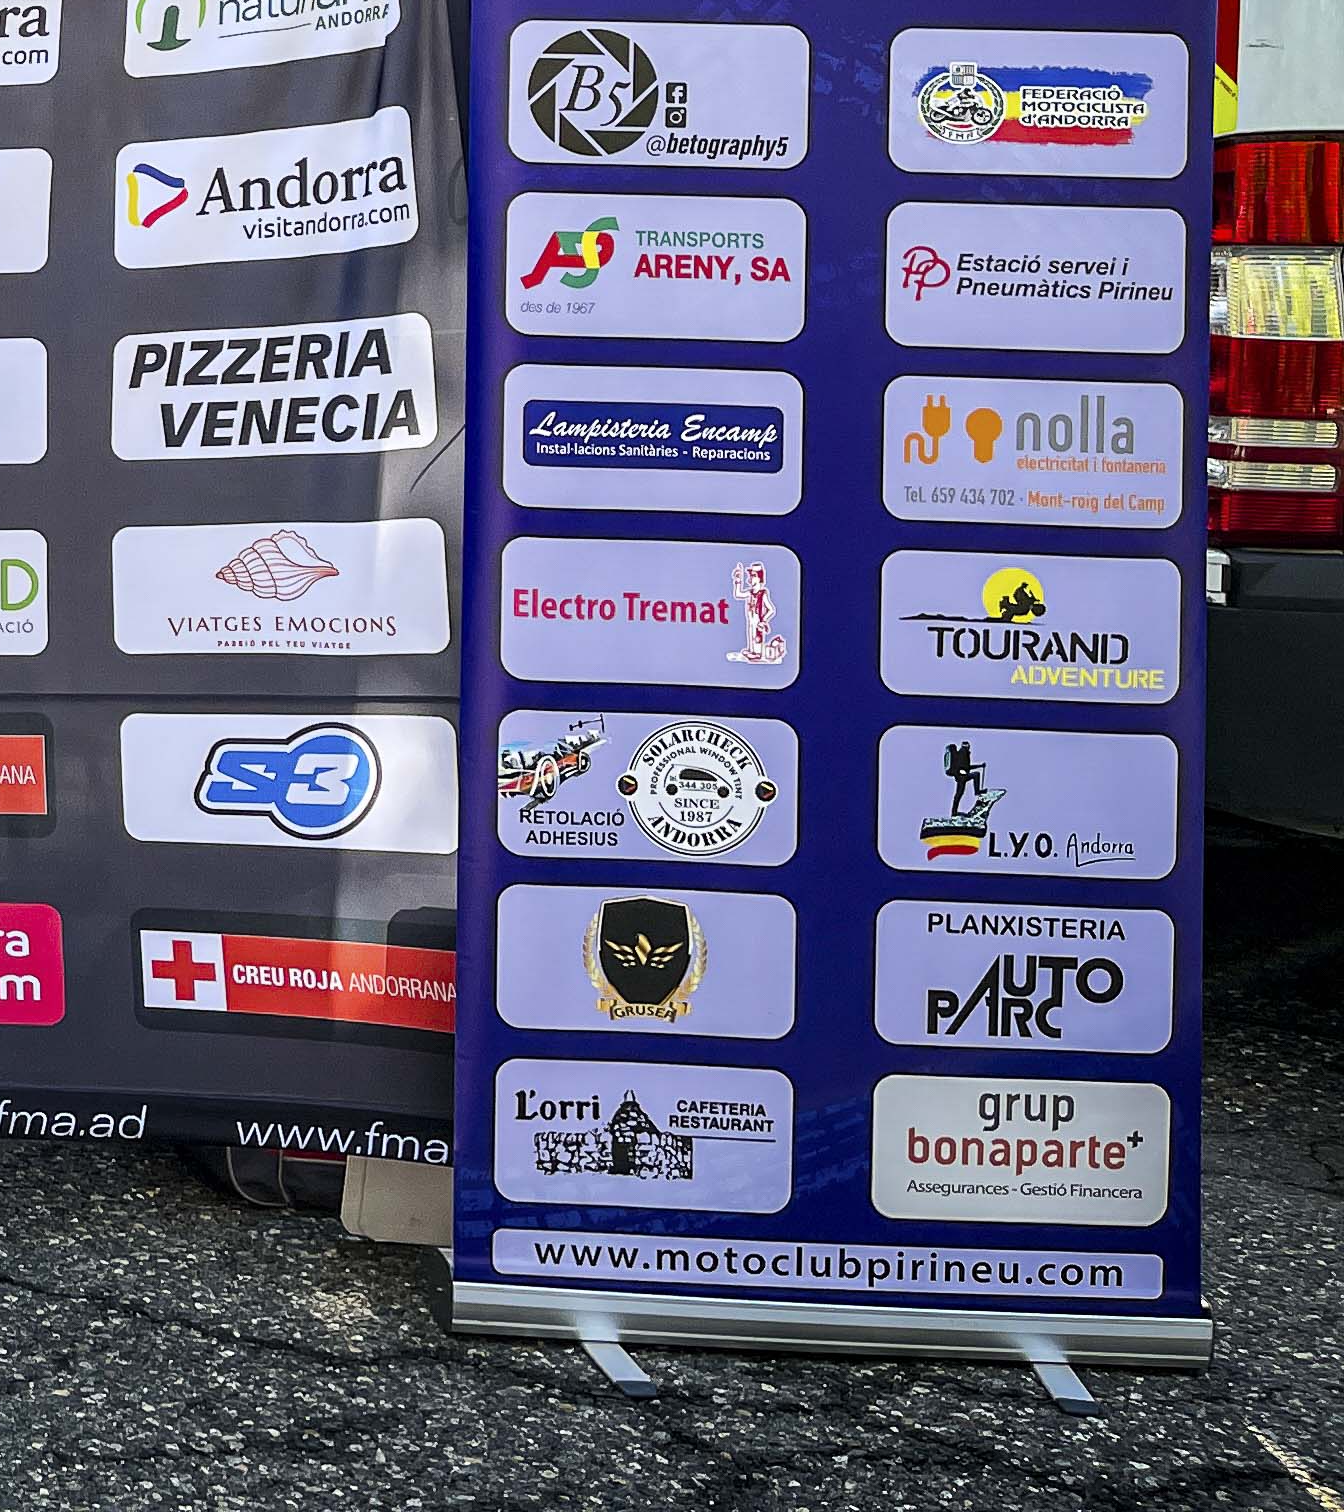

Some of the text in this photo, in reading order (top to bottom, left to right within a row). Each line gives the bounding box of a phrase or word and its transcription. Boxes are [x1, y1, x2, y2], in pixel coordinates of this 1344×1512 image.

[1021, 86, 1121, 100] FEDERACIÓ
[1021, 101, 1144, 115] MOTOCICLISTA
[1021, 114, 1129, 127] d'ANDORRA
[645, 132, 789, 161] @betography5
[196, 154, 408, 217] Andorra
[243, 201, 410, 241] visitandorra.com
[635, 230, 766, 250] TRANSPORTS
[633, 254, 791, 286] ARENY, SA
[956, 252, 1129, 277] Estació servei i
[955, 277, 1174, 302] Pneumàtics Pirineu
[520, 299, 596, 316] des de 1967
[127, 327, 393, 390] PIZZERIA
[159, 389, 422, 449] VENECIA
[527, 408, 779, 447] Lampisteria Encamp
[1017, 393, 1135, 455] nolla
[619, 443, 679, 460] Sanitàries
[692, 445, 771, 464] Reparacions
[1016, 454, 1091, 474] electricitat
[1101, 456, 1167, 476] fontaneria
[931, 486, 957, 506] 659
[960, 487, 986, 507] 434
[989, 488, 1015, 507] 702
[1026, 490, 1100, 514] Mont-roig
[1103, 492, 1125, 512] del
[1128, 493, 1166, 515] Camp
[513, 588, 730, 626] Electro Tremat
[167, 614, 398, 637] VIATGES EMOCIONS
[261, 640, 280, 649] PEL
[287, 640, 305, 649] TEU
[311, 640, 351, 649] VIATGE
[927, 627, 1130, 666] TOURAND
[1010, 665, 1165, 690] ADVENTURE
[642, 729, 753, 771] SOLARCHECK
[650, 746, 743, 800] PROFESSIONAL WINDOW TINT
[674, 797, 720, 809] SINCE
[519, 809, 626, 827] RETOLACIÓ
[679, 810, 713, 823] 1987
[525, 830, 618, 847] ADHESIUS
[647, 815, 743, 848] ANDORRA
[1066, 830, 1135, 857] Andorra
[927, 913, 1125, 941] PLANXISTERIA
[232, 963, 284, 986] CREU
[288, 966, 343, 991] ROJA
[676, 1099, 767, 1116] CAFETERIA
[978, 1090, 1076, 1130] grup
[668, 1114, 774, 1134] RESTAURANT
[906, 1178, 1143, 1200] Assegurances Gestió Financera
[533, 1236, 1124, 1289] www.motoclubpirineu.com
